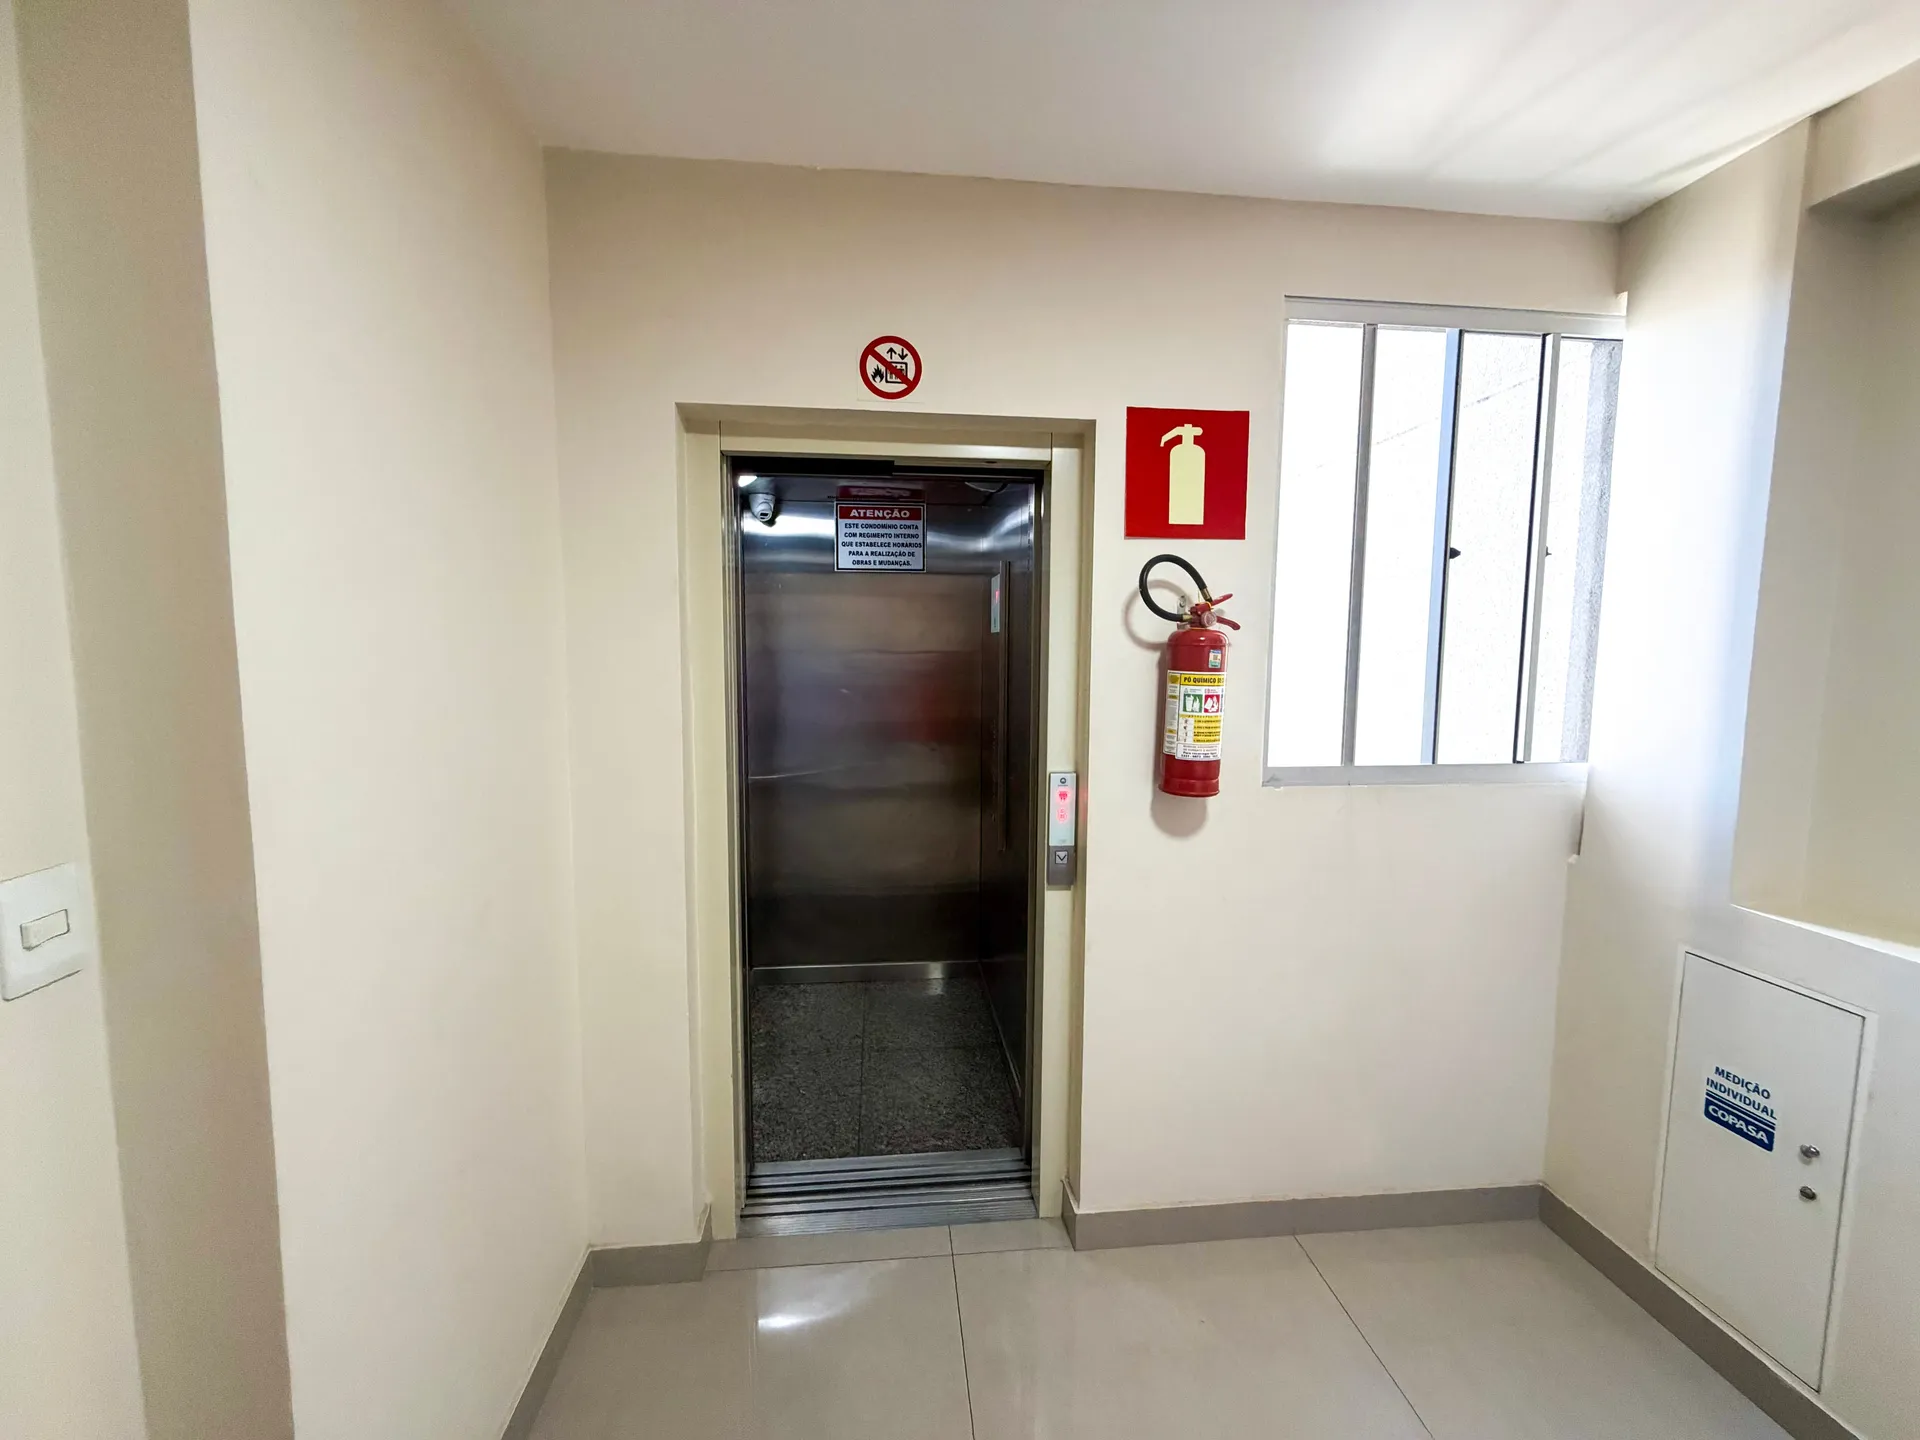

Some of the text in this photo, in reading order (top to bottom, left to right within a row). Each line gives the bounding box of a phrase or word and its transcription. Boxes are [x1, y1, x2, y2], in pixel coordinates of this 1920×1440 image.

[850, 508, 910, 519] ATENÇÃO
[1706, 1077, 1777, 1120] INDIVIDUAL
[1714, 1066, 1770, 1099] MEDIÇÃO
[1708, 1105, 1769, 1144] COPASA
